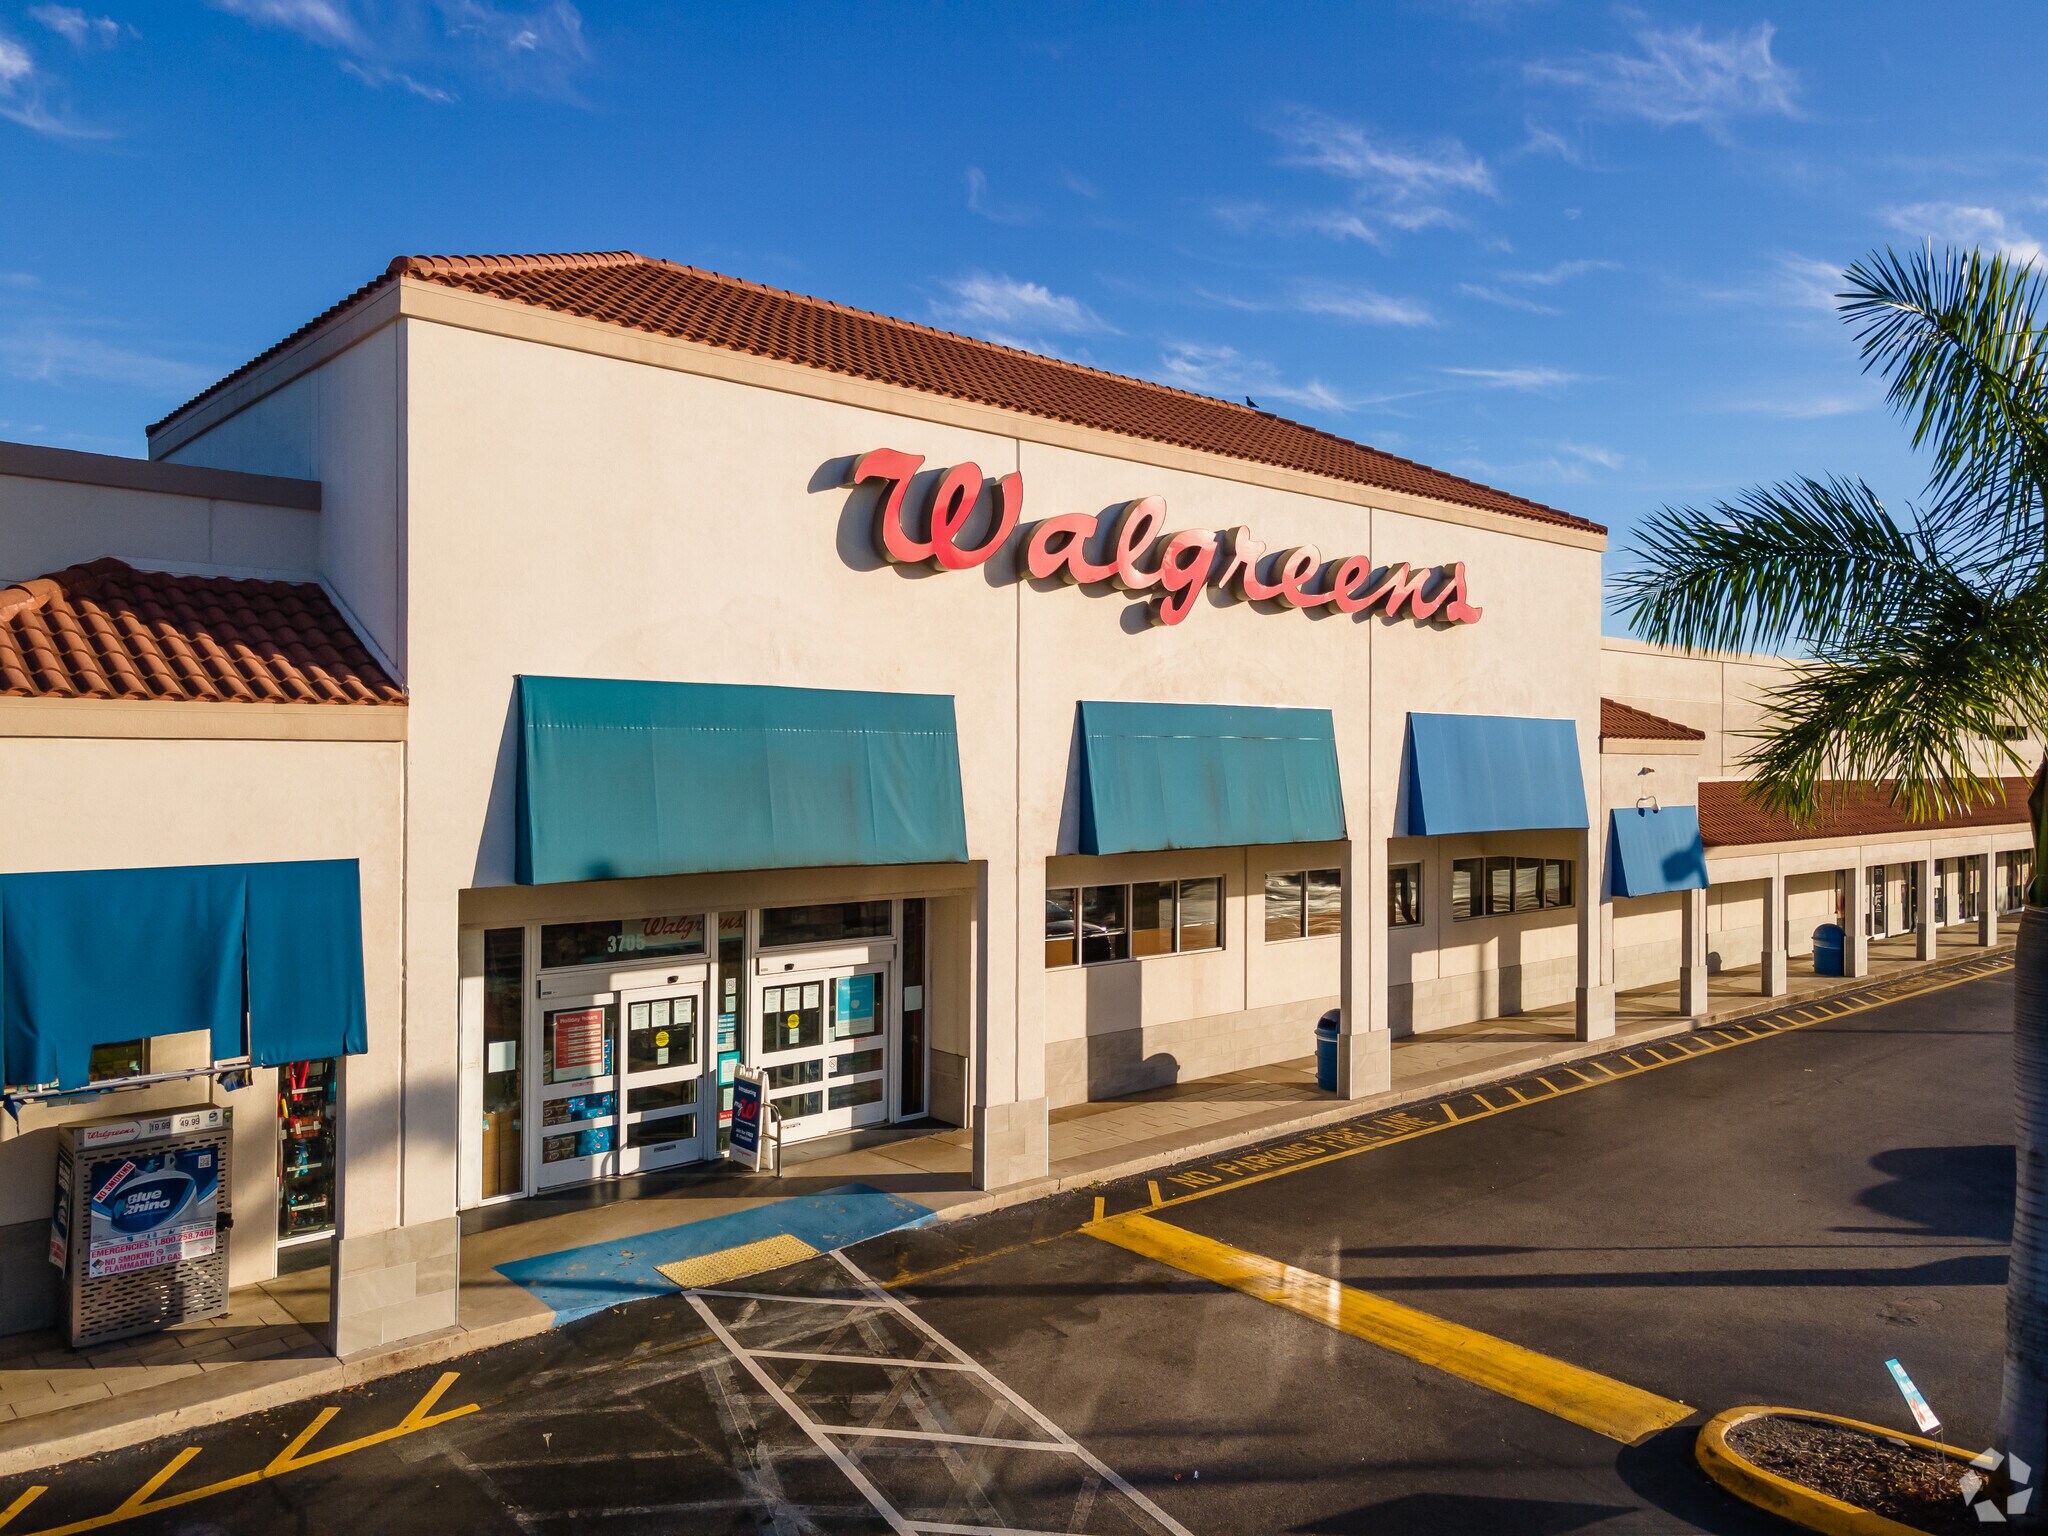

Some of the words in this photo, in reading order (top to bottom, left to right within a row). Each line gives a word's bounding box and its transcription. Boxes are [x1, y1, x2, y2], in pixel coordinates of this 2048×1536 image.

[853, 447, 1483, 626] Walgreens
[86, 1127, 136, 1140] Walgreens
[1167, 1171, 1222, 1188] NO
[1213, 1143, 1327, 1176] PARKING
[1306, 1127, 1384, 1149] FIRE
[1356, 1112, 1439, 1136] LANE
[95, 1190, 107, 1201] NO
[105, 1163, 134, 1191] SMOKING
[127, 1190, 162, 1205] Blue
[91, 1241, 153, 1258] EMERGENCIES:
[104, 1258, 116, 1266] NO
[118, 1250, 155, 1264] SMOKING
[104, 1258, 154, 1274] FLAMMABLE
[156, 1255, 166, 1264] LP
[167, 1251, 183, 1261] GAS
